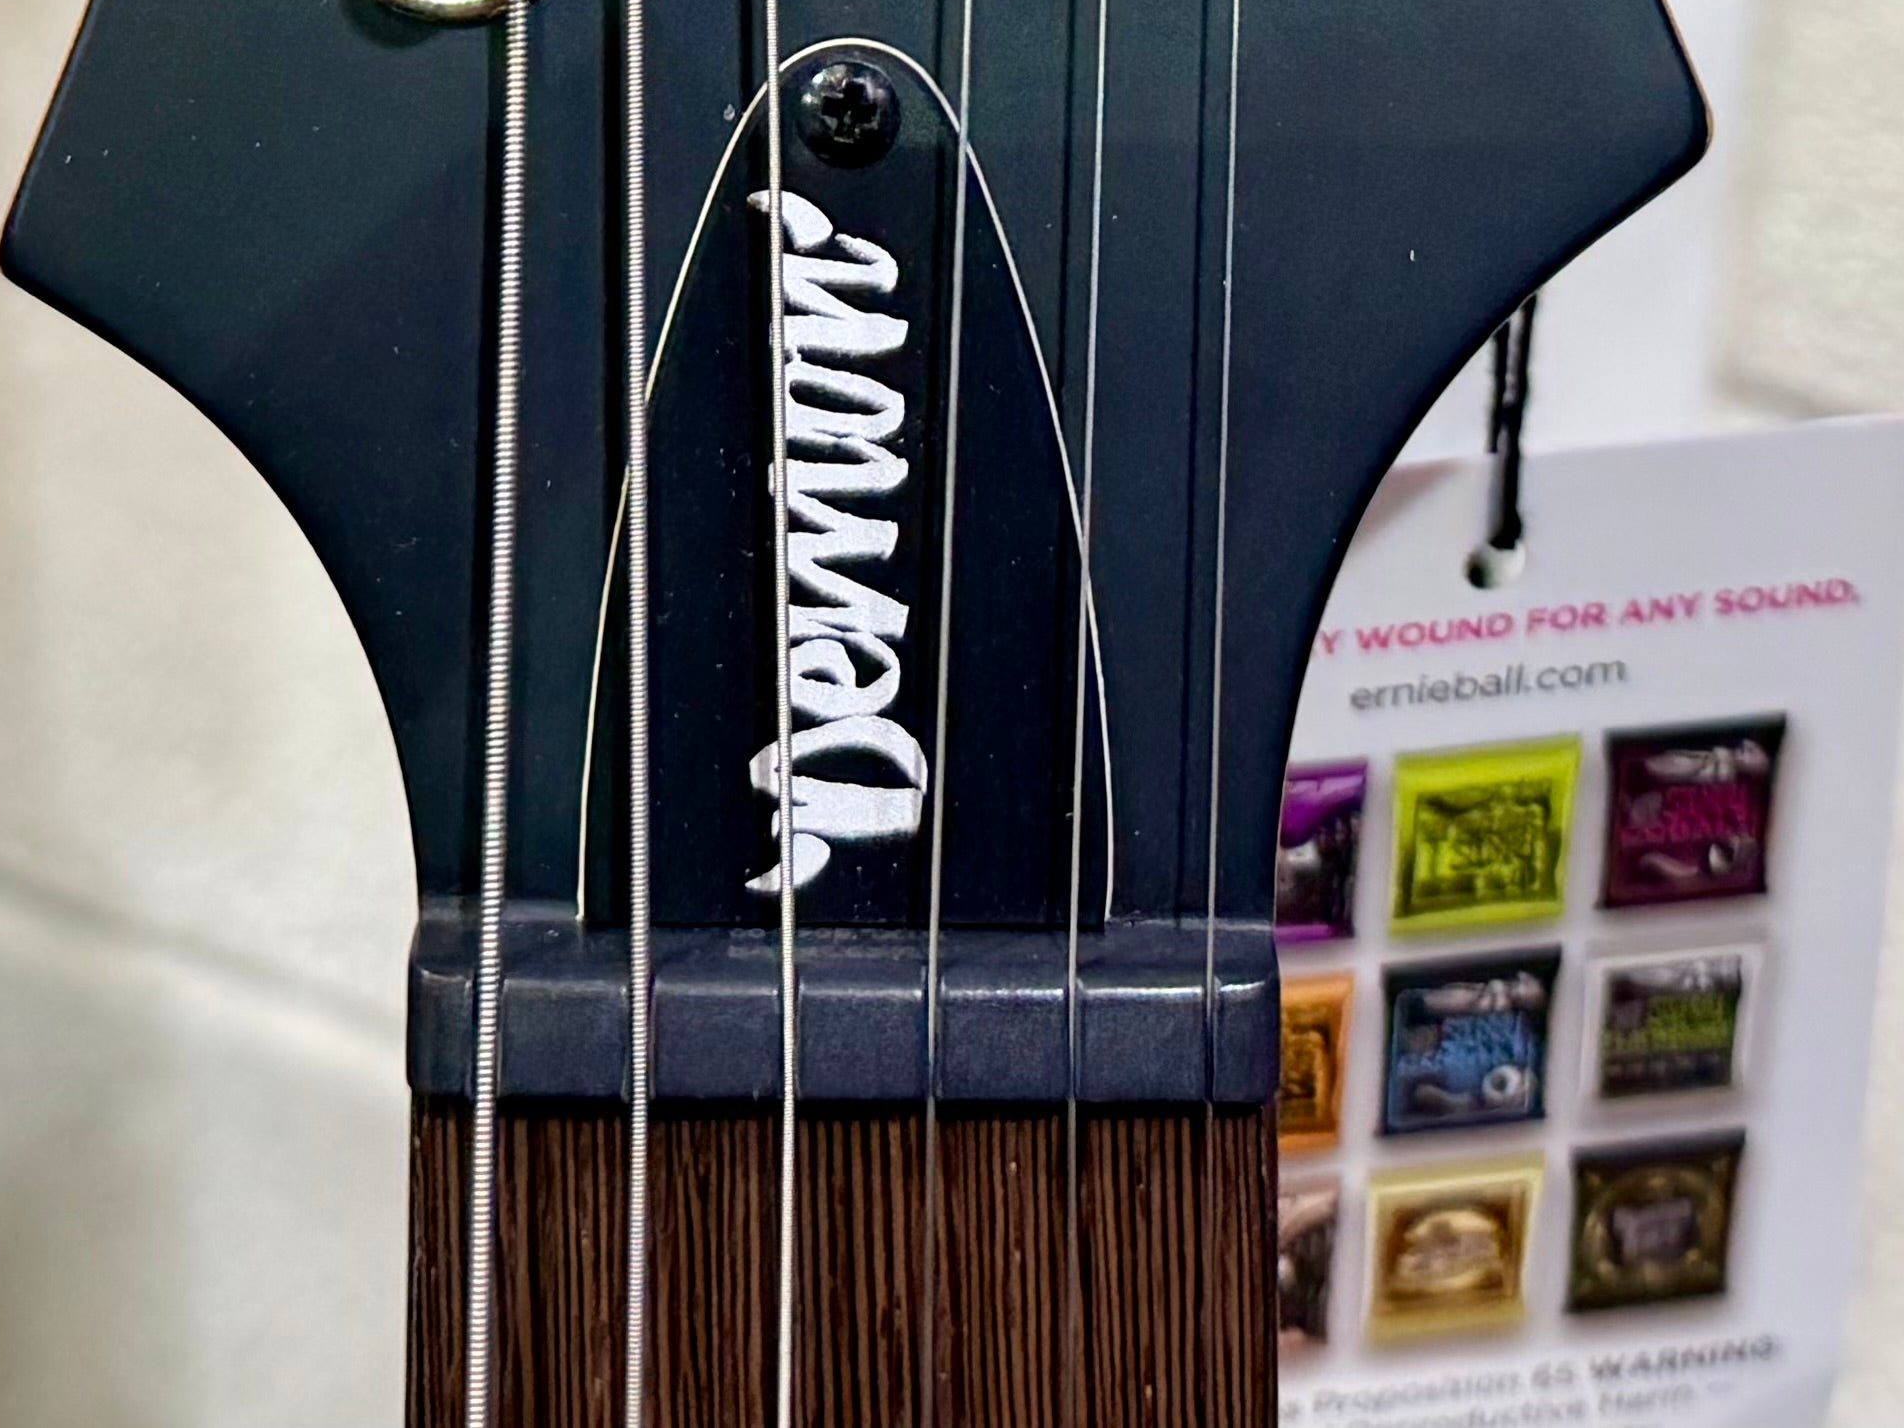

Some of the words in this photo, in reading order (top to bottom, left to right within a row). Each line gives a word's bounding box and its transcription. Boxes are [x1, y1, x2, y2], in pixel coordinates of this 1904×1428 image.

[746, 189, 928, 893] Demon
[1355, 611, 1516, 652] WOUND
[1526, 601, 1607, 634] FOR
[1619, 591, 1702, 625] ANY
[1349, 659, 1628, 713] ernieball.com
